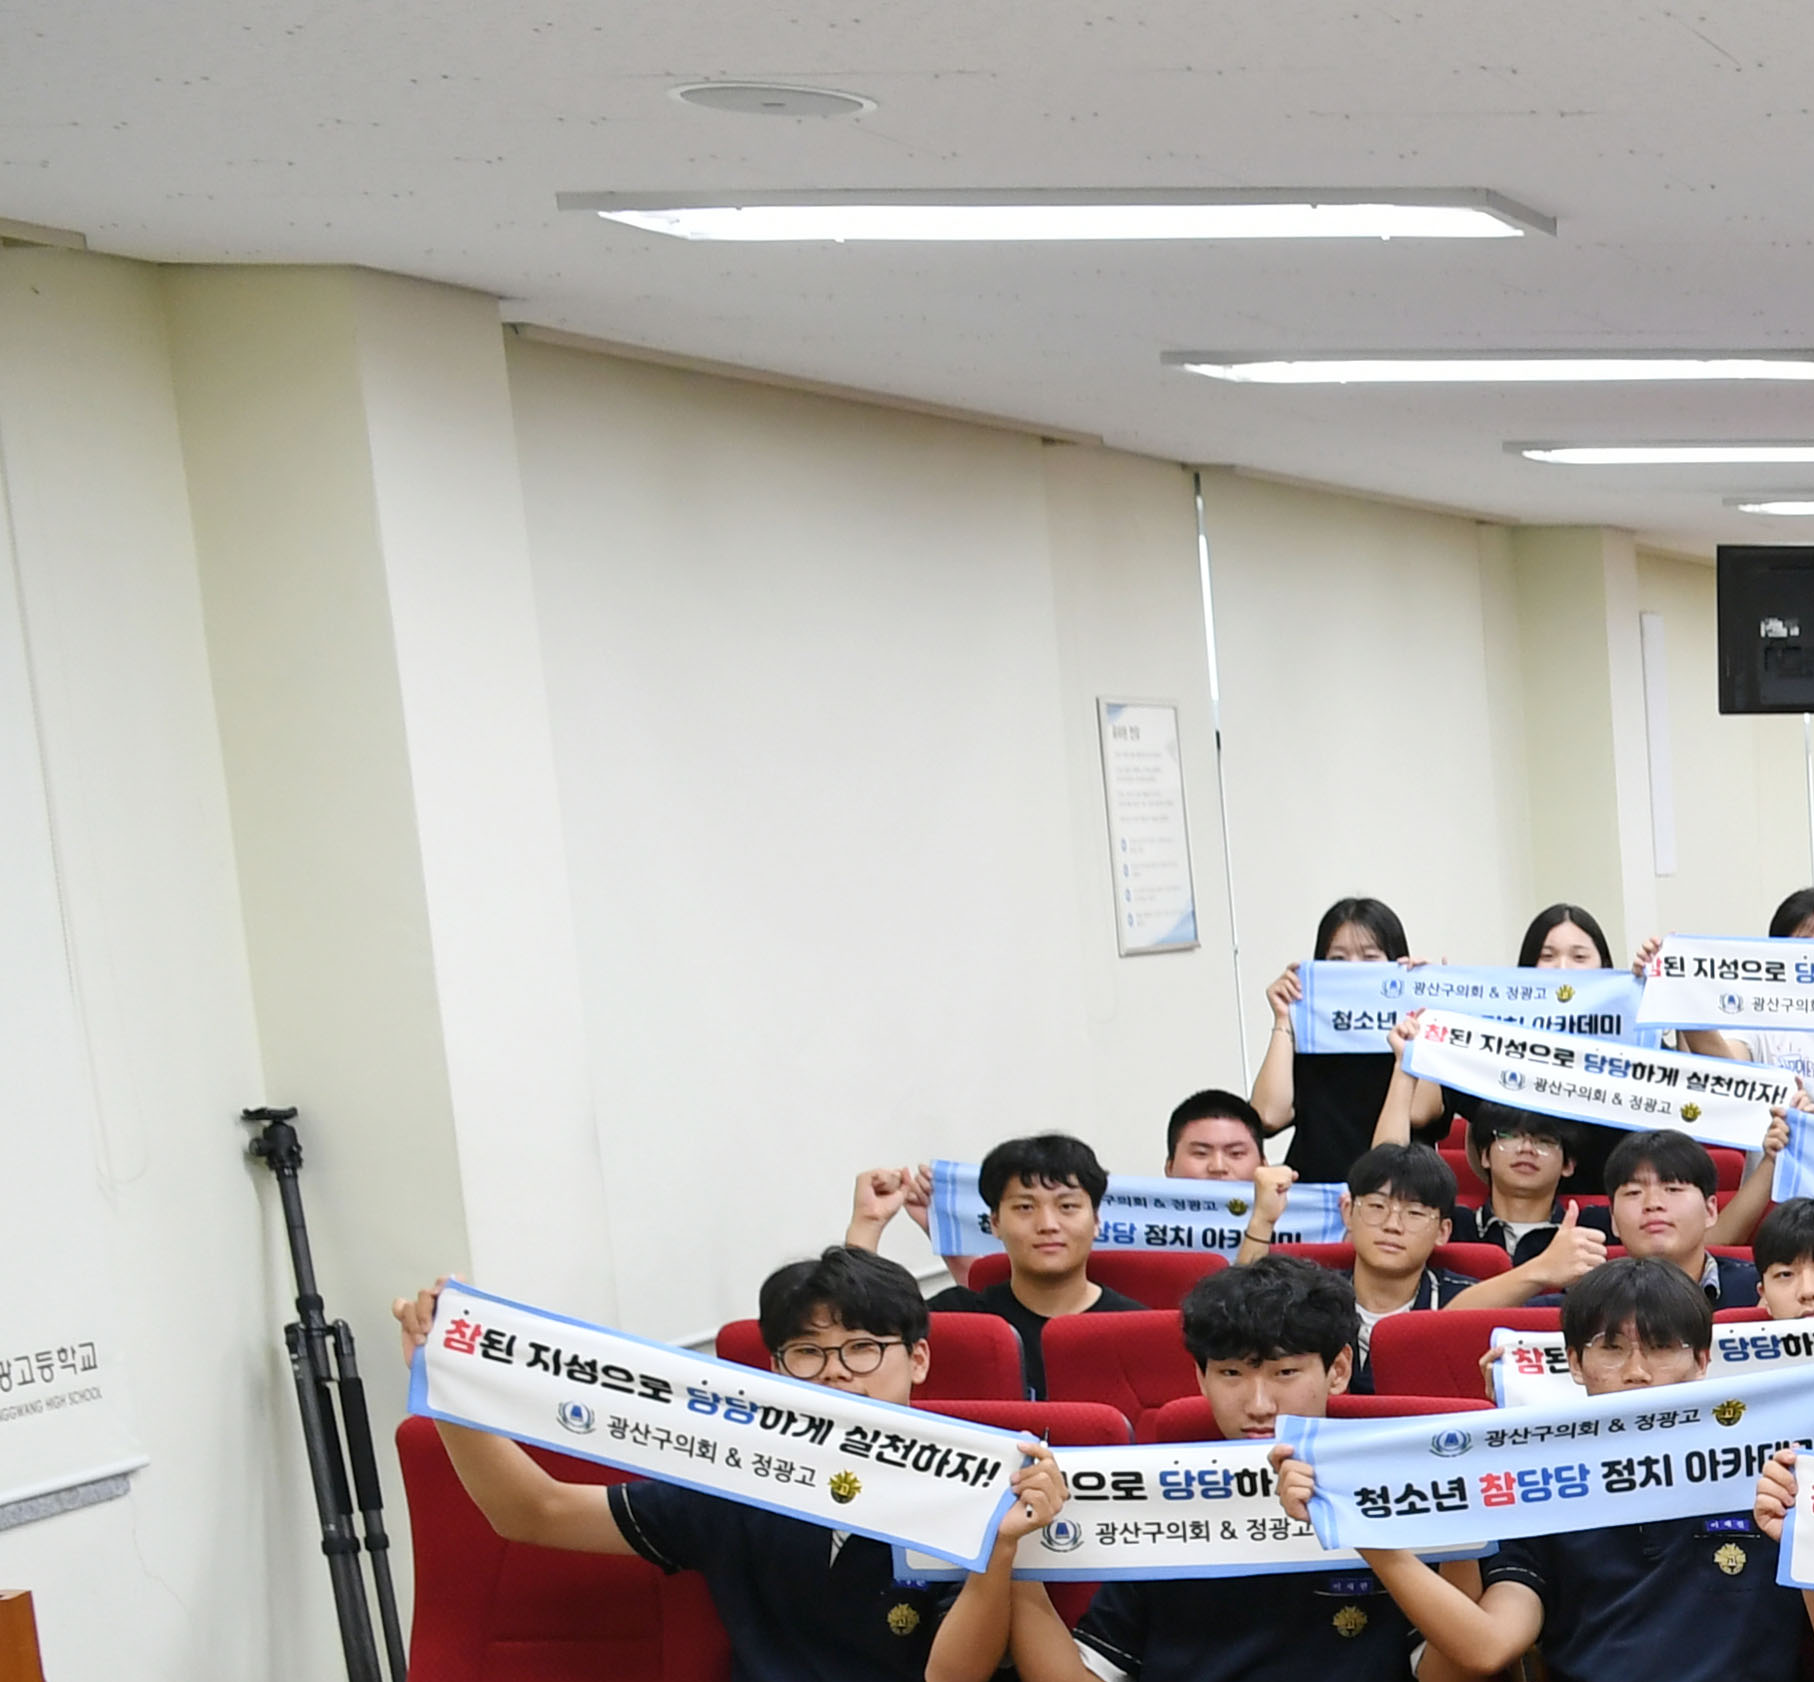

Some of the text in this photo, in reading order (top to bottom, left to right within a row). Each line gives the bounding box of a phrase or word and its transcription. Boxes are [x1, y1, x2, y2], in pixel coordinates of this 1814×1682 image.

[1694, 958, 1785, 982] 지성으로
[1415, 982, 1546, 1000] 광산구의회 정광고
[1332, 1011, 1396, 1031] 청소년
[1430, 1025, 1787, 1104] 참된 지성으로 당당하게 실천하자!
[1534, 1078, 1671, 1114] 광산구의회 정광고
[1171, 1199, 1218, 1211] 정광고
[1145, 1225, 1192, 1248] 정치
[46, 1396, 65, 1409] HIGH
[68, 1387, 102, 1405] SCHOOL
[444, 1320, 1001, 1487] 참된 지성으로 당당하게 실천하자!
[1485, 1409, 1700, 1447] 광산구의회 정광고
[608, 1416, 815, 1487] 광산구의회 & 정광고
[1354, 1454, 1673, 1518] 청소년 참당당 정치
[1096, 1512, 1314, 1545] 광산구의회 & 정광고
